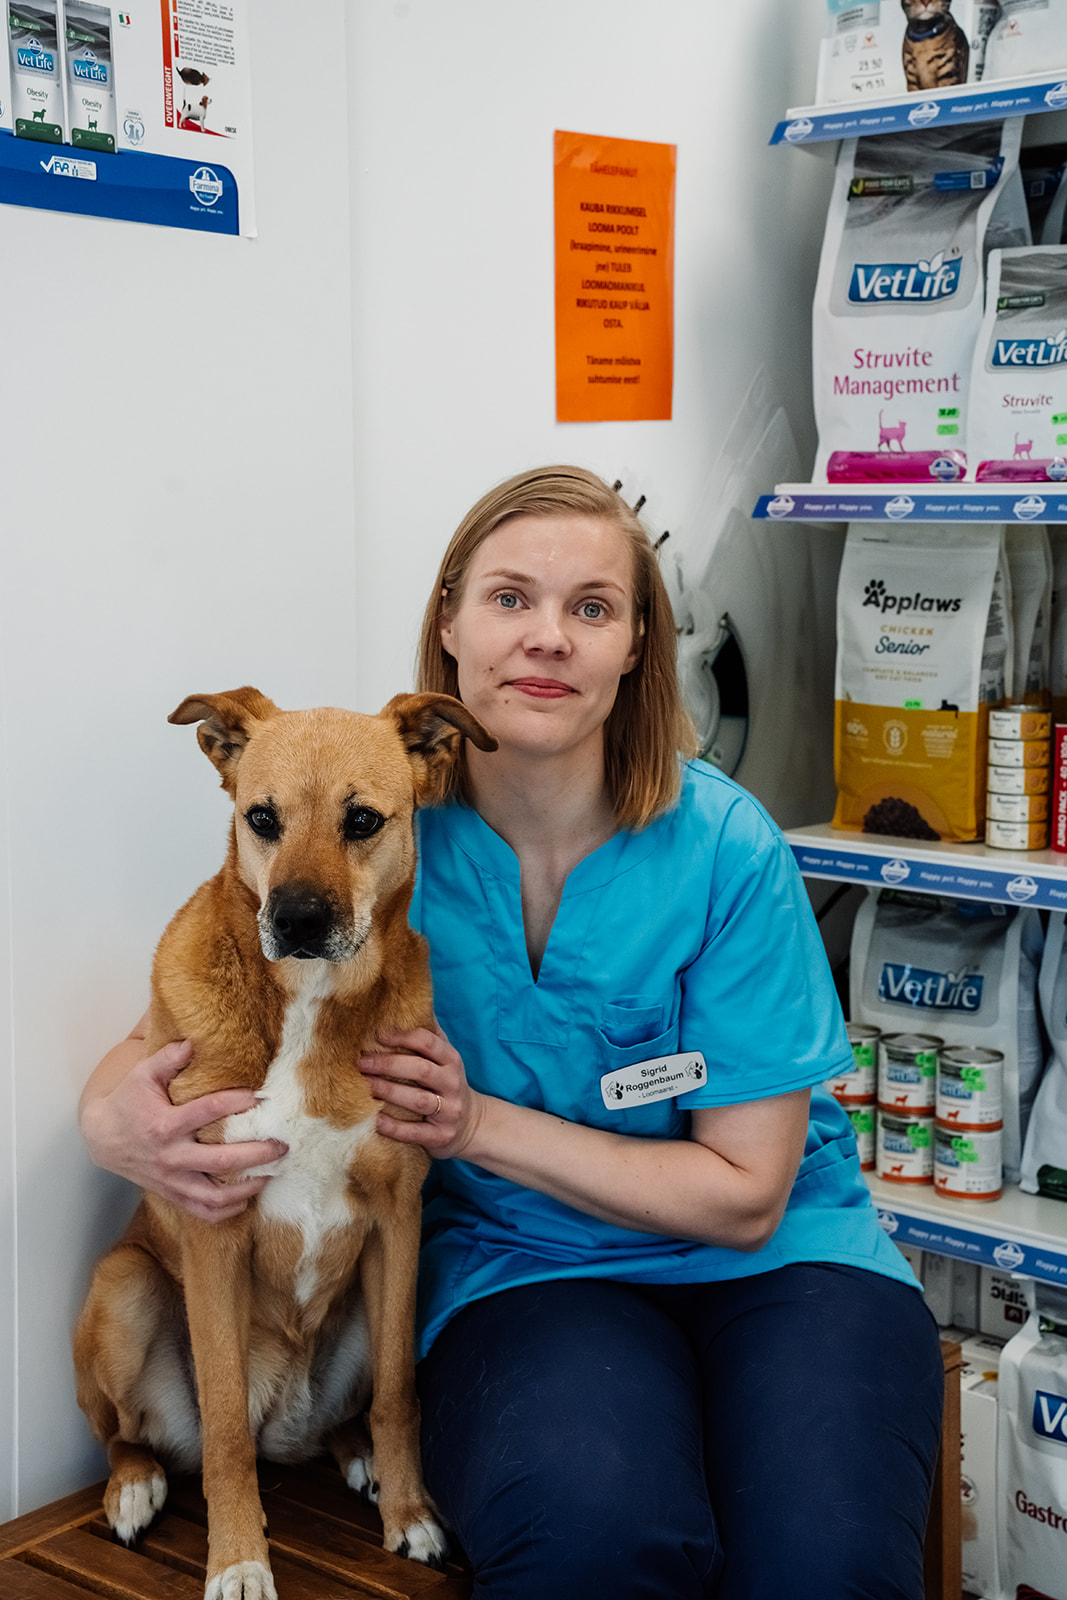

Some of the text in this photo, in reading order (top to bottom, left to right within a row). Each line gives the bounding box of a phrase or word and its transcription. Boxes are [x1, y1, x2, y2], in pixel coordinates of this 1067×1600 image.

[18, 52, 53, 70] Vet Life
[74, 64, 106, 82] Vet Life
[27, 87, 48, 99] Obesity
[164, 65, 173, 123] OVERWEIGHT
[82, 98, 102, 110] Obesity
[193, 180, 219, 193] Farmina
[580, 202, 604, 213] KAUBA
[588, 222, 639, 235] LOOMA POOLT
[611, 262, 632, 273] TULEB
[856, 260, 956, 299] VetLife
[609, 300, 628, 310] KAUP
[854, 347, 932, 369] Struvite
[833, 373, 961, 400] Management
[1002, 393, 1053, 408] Struvite
[862, 587, 962, 615] Applaws
[880, 624, 934, 636] CHICKEN
[875, 636, 930, 656] Senior
[1060, 767, 1067, 779] 40
[1058, 790, 1067, 813] PACK
[1057, 814, 1066, 847] JUMBO
[886, 967, 978, 1008] VetLife
[641, 1064, 667, 1078] Sigrid
[626, 1072, 684, 1092] Roggenbaum
[642, 1086, 674, 1098] Loomaarst
